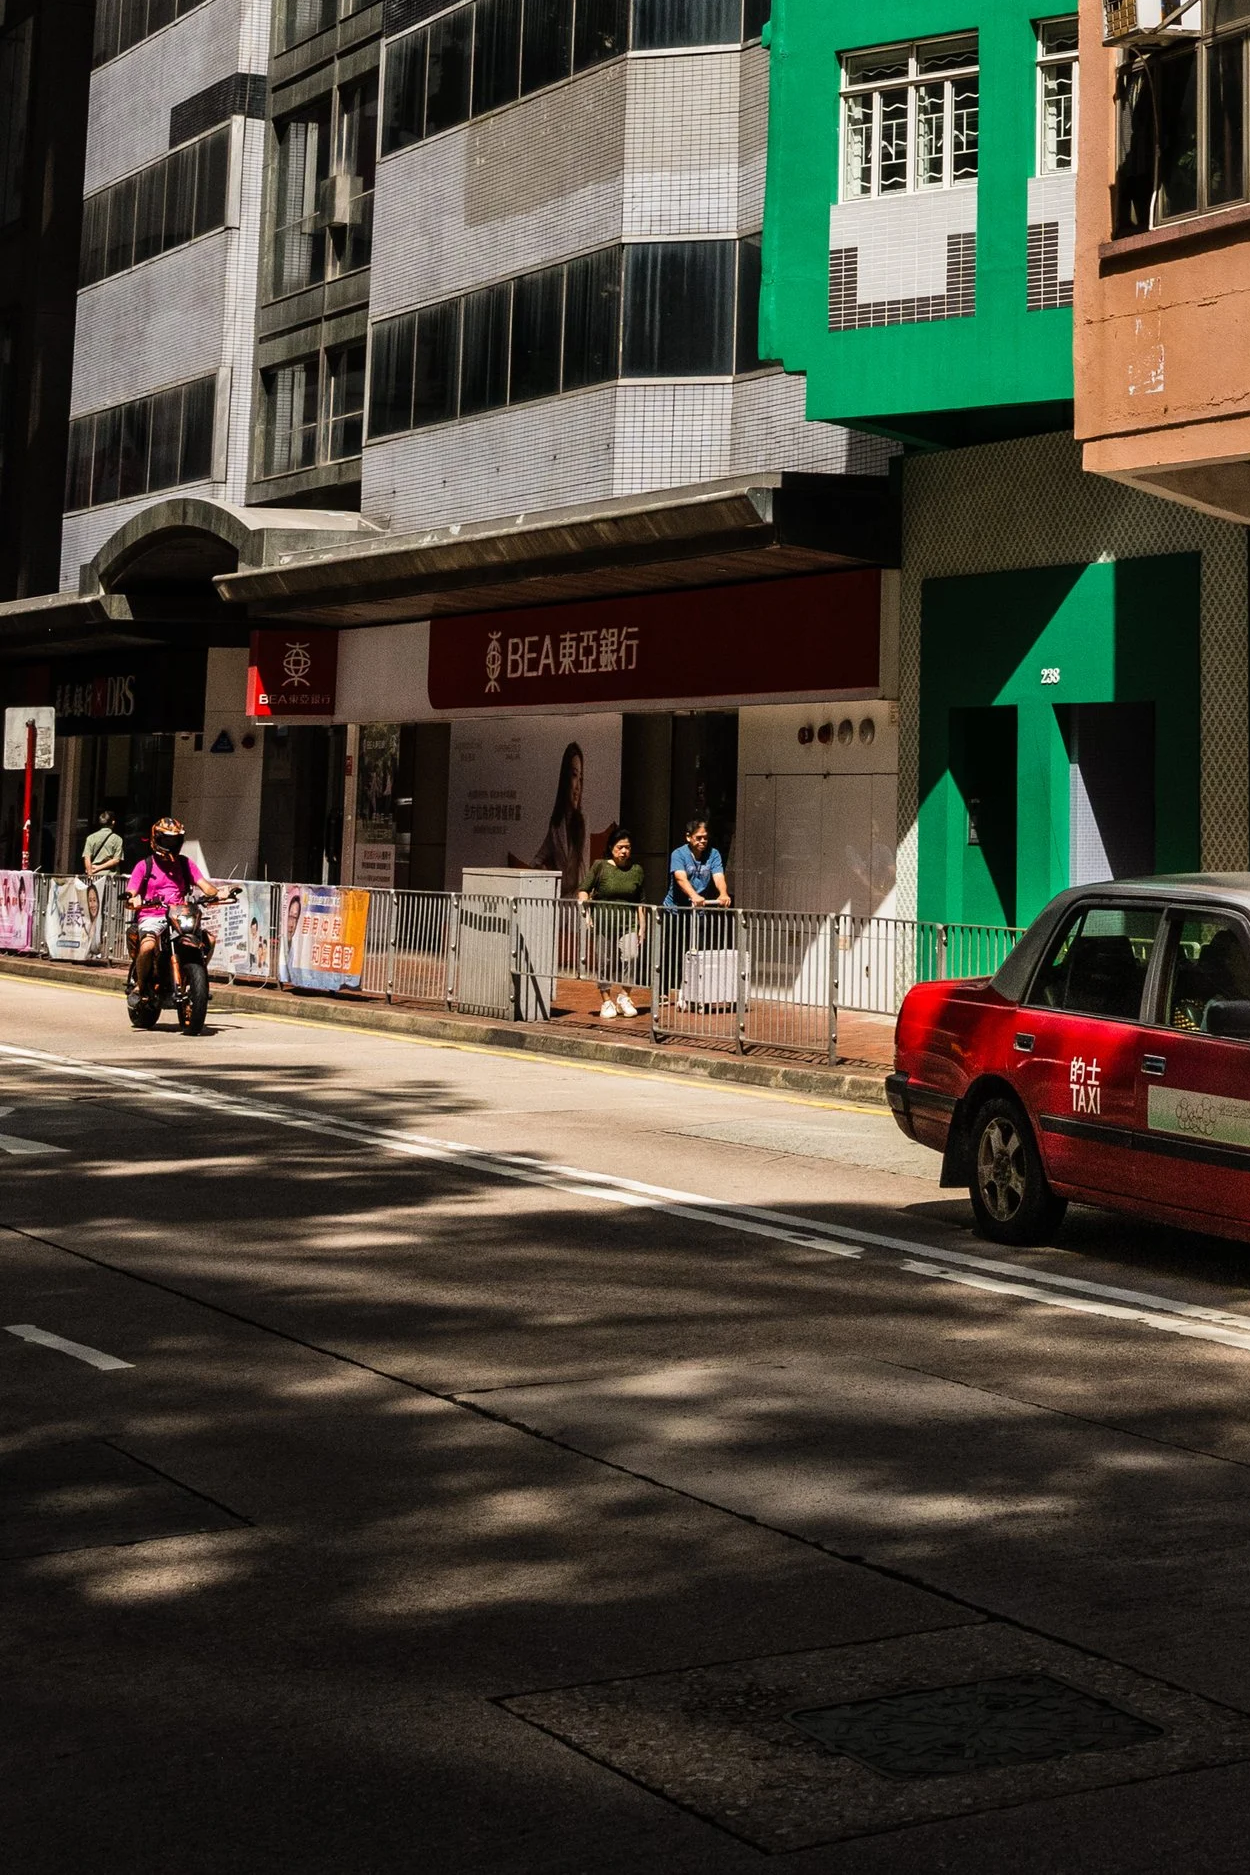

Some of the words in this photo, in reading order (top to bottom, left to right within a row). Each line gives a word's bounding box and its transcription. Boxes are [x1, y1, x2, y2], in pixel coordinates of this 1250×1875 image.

[507, 635, 556, 678] BEA
[558, 627, 640, 675] 東亞銀行
[1041, 668, 1060, 684] 238
[105, 675, 136, 716] DBS
[259, 694, 288, 705] BEA
[288, 693, 331, 705] 東亞銀行
[1070, 1056, 1101, 1085] 的士
[1070, 1084, 1101, 1115] TAXI
